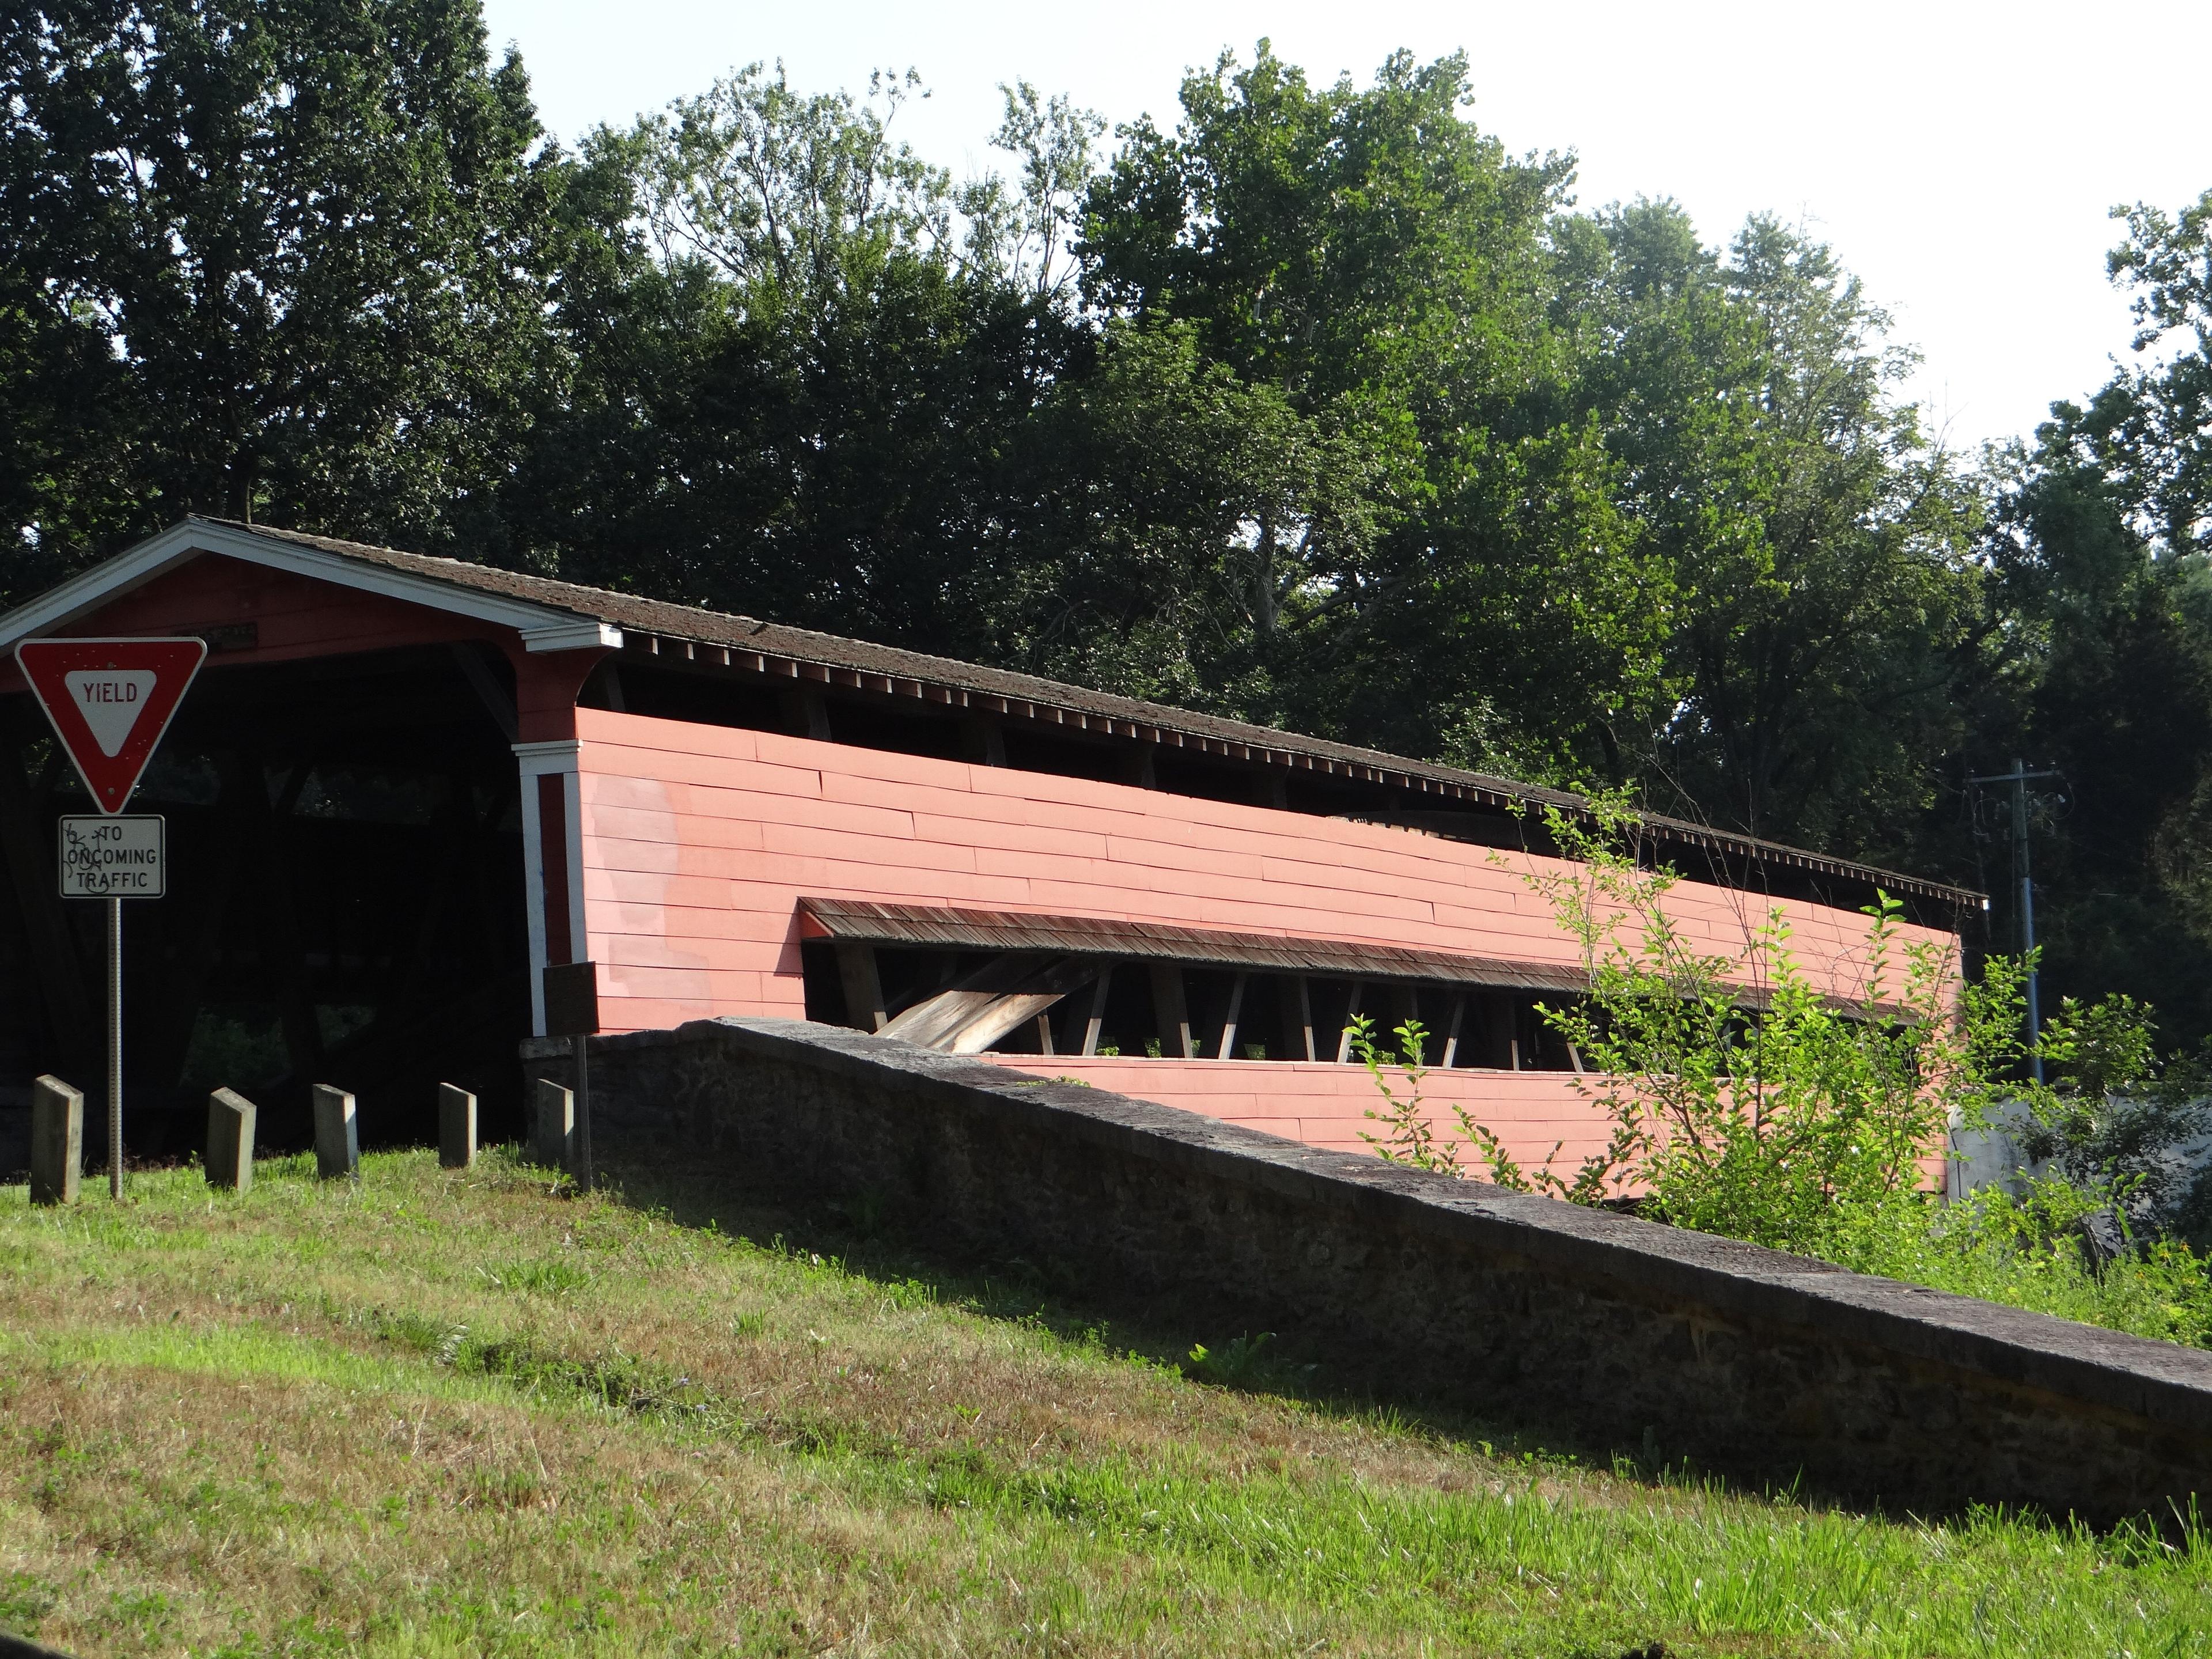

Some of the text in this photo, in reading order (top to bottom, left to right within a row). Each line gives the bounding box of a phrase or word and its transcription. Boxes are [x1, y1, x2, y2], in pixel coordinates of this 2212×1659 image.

[84, 683, 137, 702] YIELD
[101, 826, 122, 840] TO
[68, 849, 156, 864] ONCOMING
[77, 872, 147, 887] TRAFFIC
